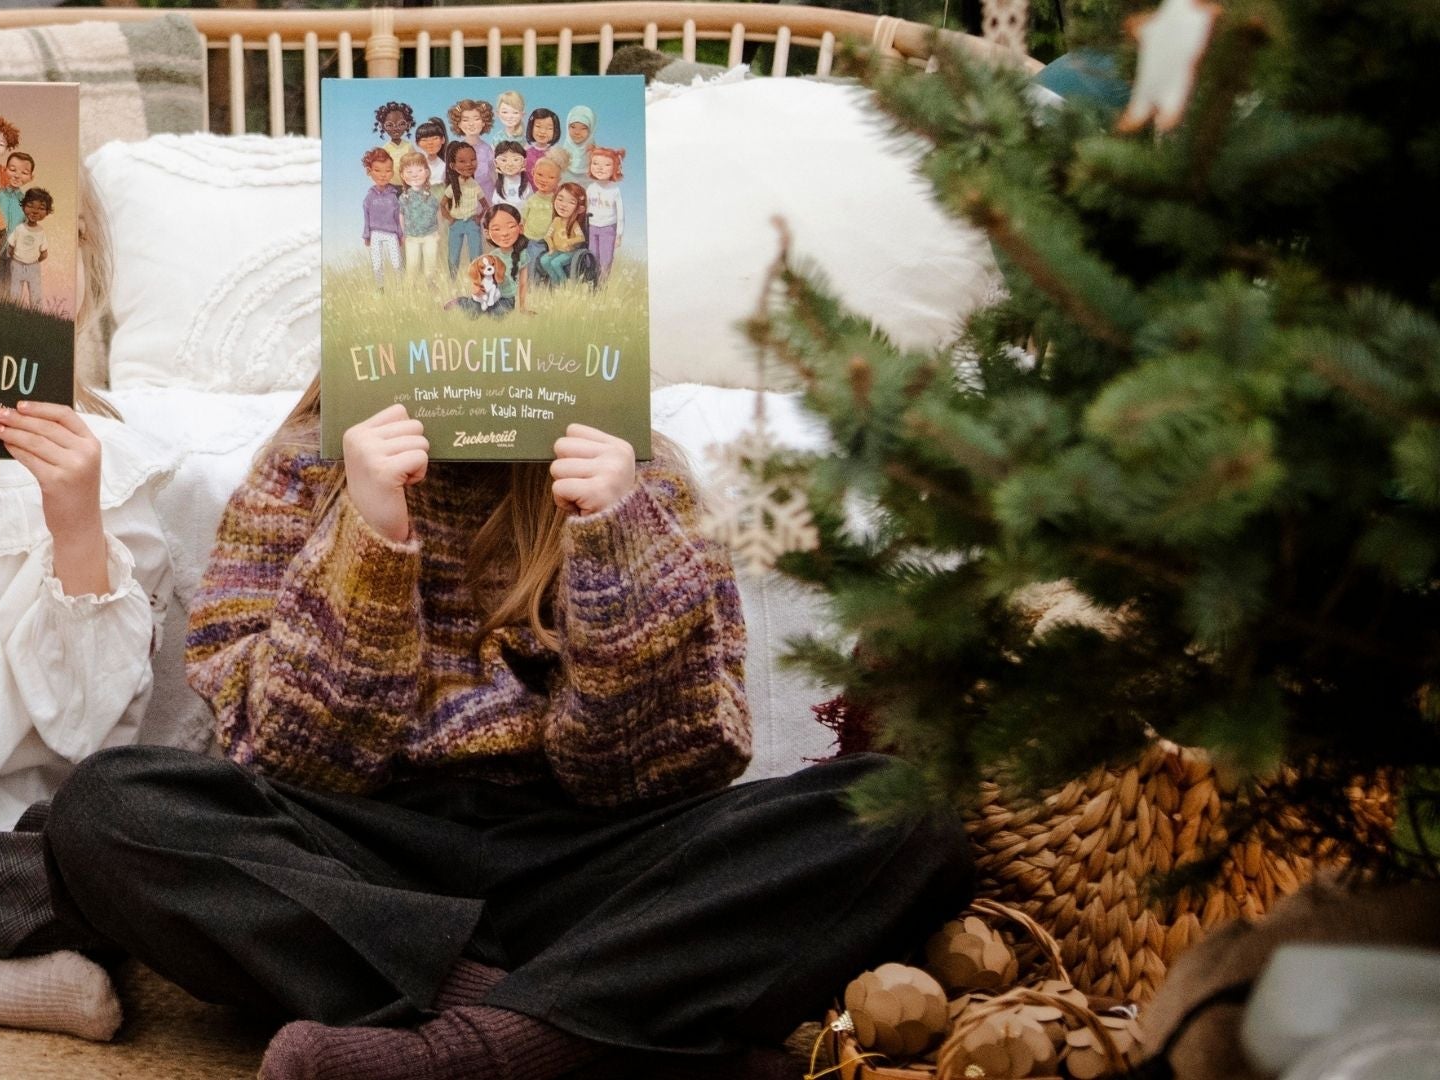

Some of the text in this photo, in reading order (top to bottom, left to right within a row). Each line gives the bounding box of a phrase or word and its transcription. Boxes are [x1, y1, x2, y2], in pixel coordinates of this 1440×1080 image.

[350, 333, 621, 381] EIN MÄDCHEN wie DU
[0, 355, 39, 395] DU
[414, 387, 439, 401] Frank
[443, 385, 482, 401] Murphy
[509, 386, 533, 399] Carla
[537, 387, 577, 405] Murphy
[490, 403, 517, 419] Kayla
[521, 405, 554, 420] Harren
[452, 430, 517, 447] Zuckersüß
